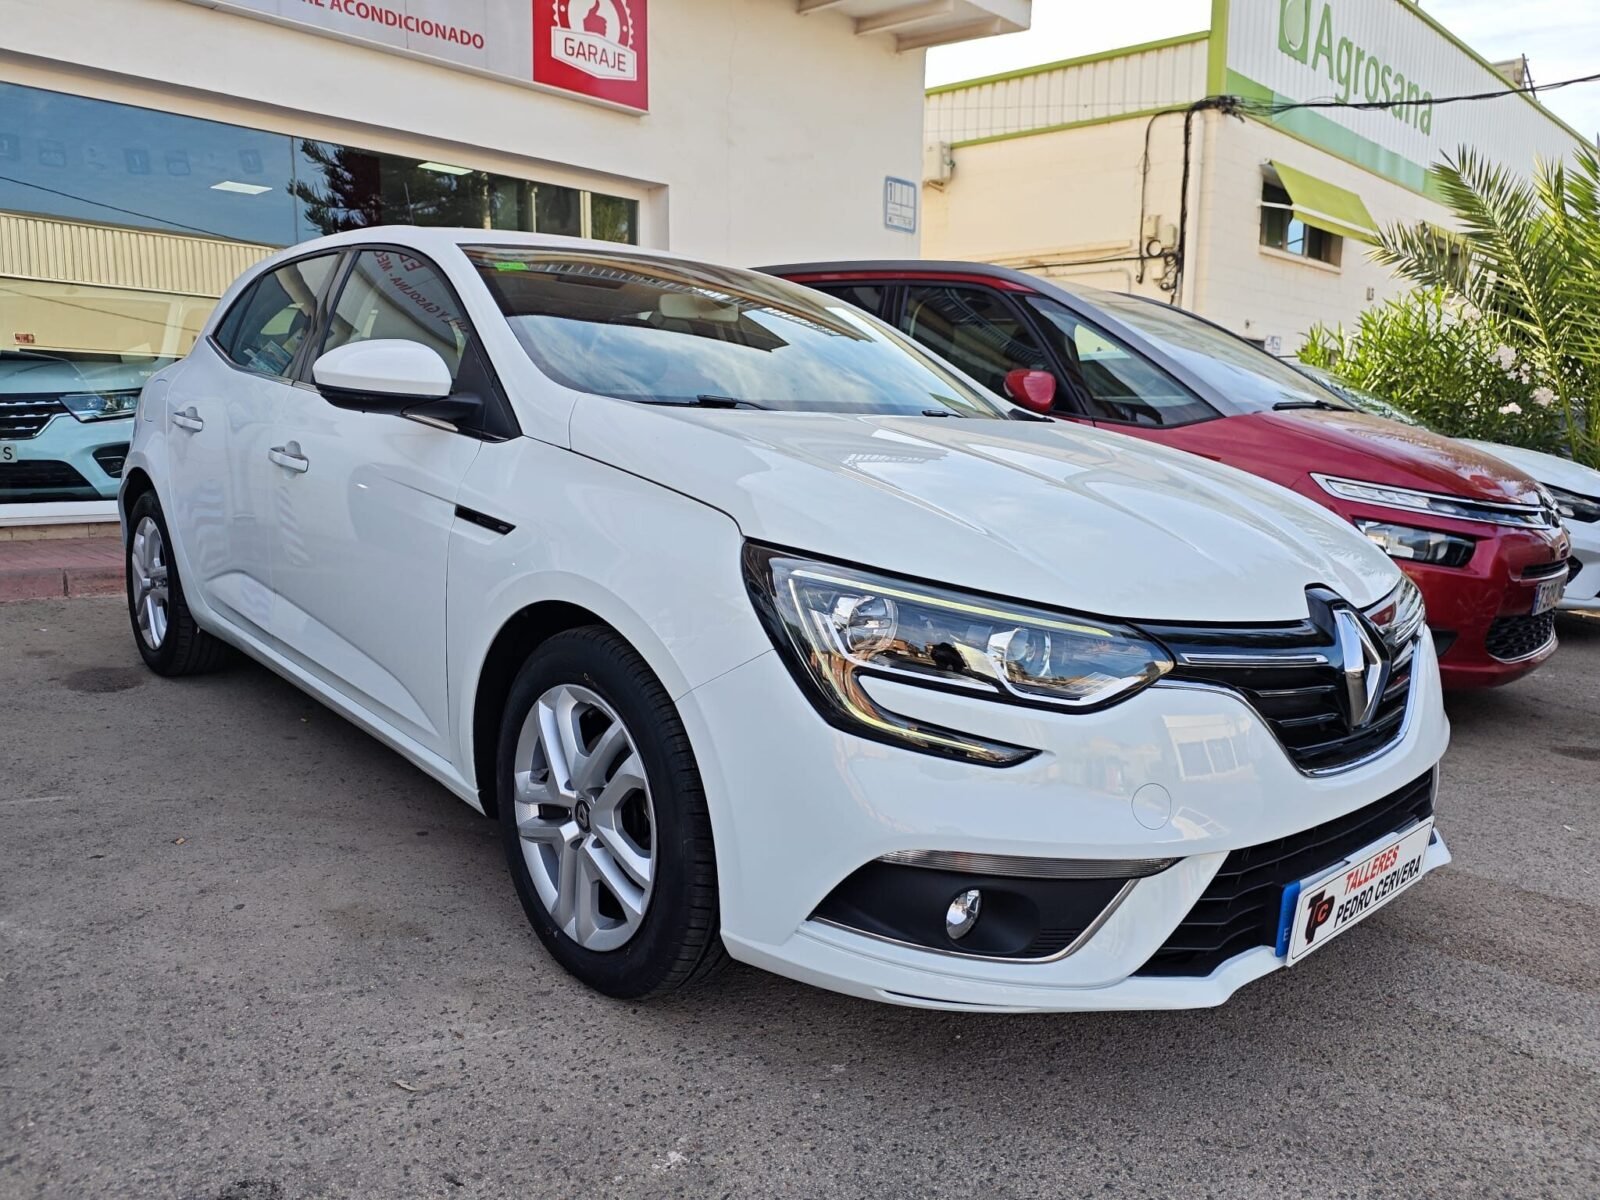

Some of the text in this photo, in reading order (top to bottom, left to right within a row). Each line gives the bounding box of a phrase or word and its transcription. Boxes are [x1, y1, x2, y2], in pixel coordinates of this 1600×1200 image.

[330, 0, 484, 49] ACONDICIONADO
[564, 37, 626, 72] GARAJE
[1311, 3, 1433, 136] Agrosana
[1334, 855, 1421, 928] PEDRO CERVERA
[1344, 845, 1400, 895] TALLERES
